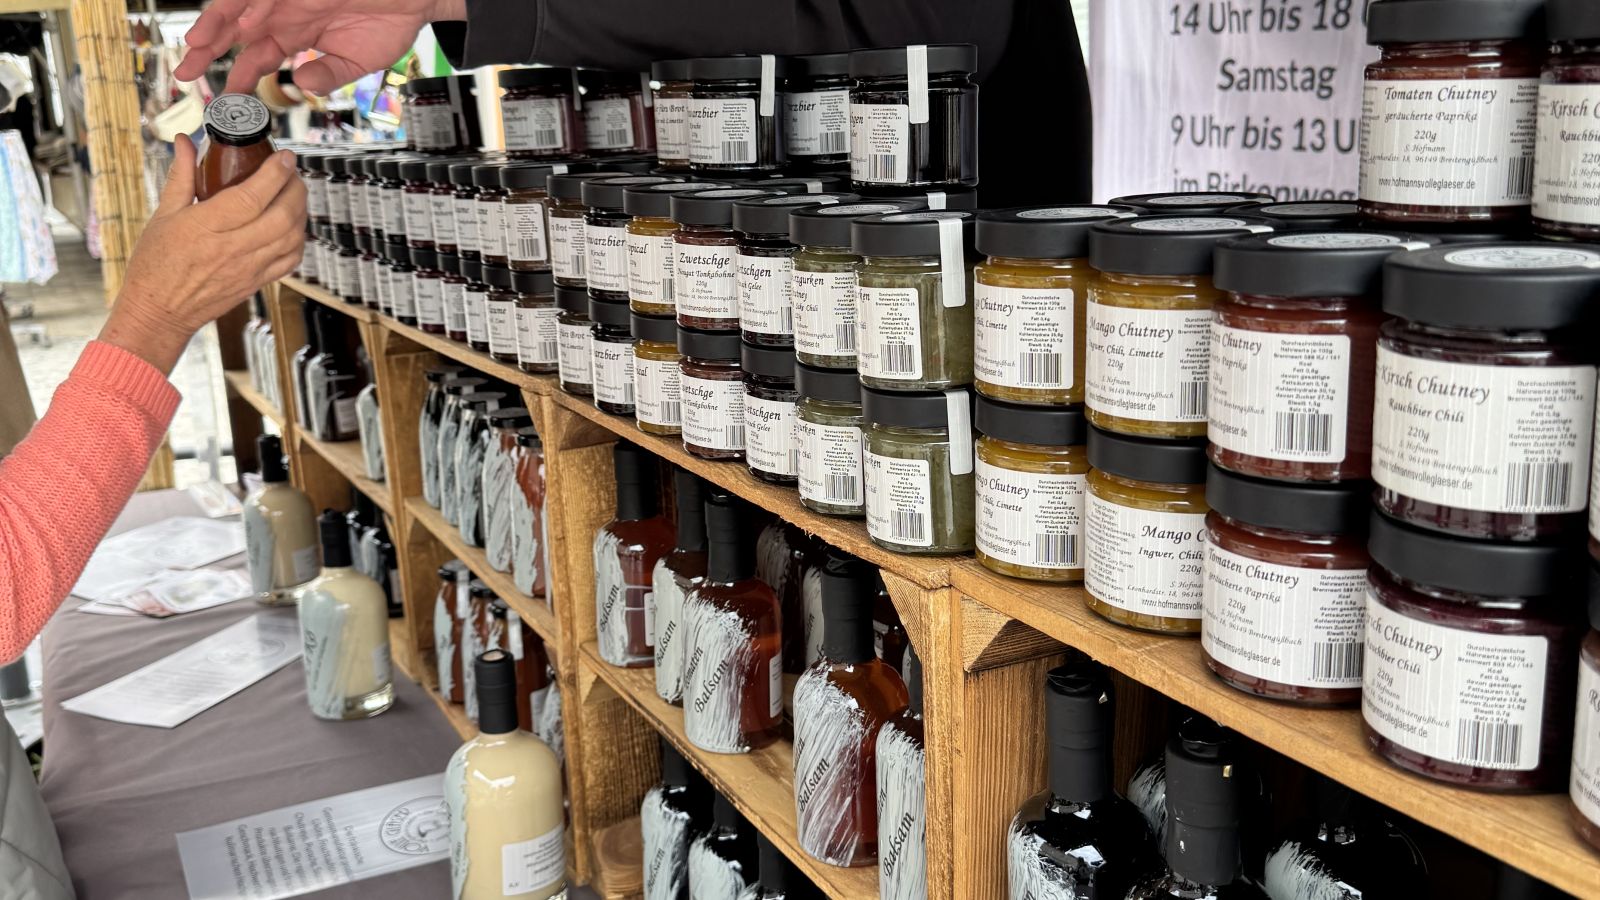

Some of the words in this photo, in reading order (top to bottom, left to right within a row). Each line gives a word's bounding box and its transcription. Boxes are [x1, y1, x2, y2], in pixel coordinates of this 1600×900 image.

[1171, 4, 1199, 35] 14
[1208, 2, 1252, 34] Uhr
[1259, 0, 1301, 32] bis
[1313, 0, 1350, 31] 18
[1217, 58, 1337, 100] Samstag
[1385, 86, 1432, 100] Tomaten
[1437, 85, 1497, 104] Chutney
[1436, 112, 1478, 123] Paprika
[1551, 98, 1589, 119] Kirsch
[1170, 114, 1184, 145] 9
[1190, 115, 1235, 147] Uhr
[1241, 117, 1282, 151] bis
[1292, 118, 1327, 153] 13
[1414, 130, 1437, 142] 220g
[680, 253, 730, 268] Zwetschge
[1119, 322, 1174, 343] Chutney
[1128, 347, 1164, 358] Limette
[1222, 333, 1262, 356] Chutney
[1108, 358, 1123, 371] 220g
[1381, 365, 1412, 389] Kirsch
[1417, 376, 1490, 405] Chutney
[1388, 398, 1431, 417] Rauchbier
[1434, 409, 1464, 423] Chili
[1408, 425, 1430, 443] 220g
[989, 478, 1030, 499] Chutney
[996, 500, 1022, 512] Limette
[1141, 525, 1191, 544] Mango
[1138, 546, 1174, 560] Ingwer,
[1179, 550, 1203, 561] Chili,
[1180, 565, 1202, 575] 220g
[1209, 548, 1242, 574] Tomaten
[1245, 565, 1299, 589] Chutney
[1244, 586, 1281, 604] Paprika
[1228, 598, 1246, 614] 220g
[1383, 625, 1442, 661] Chutney
[1397, 659, 1421, 674] Chili
[695, 659, 729, 714] Balsam
[799, 758, 830, 813] Balsam
[884, 811, 915, 878] Balsam
